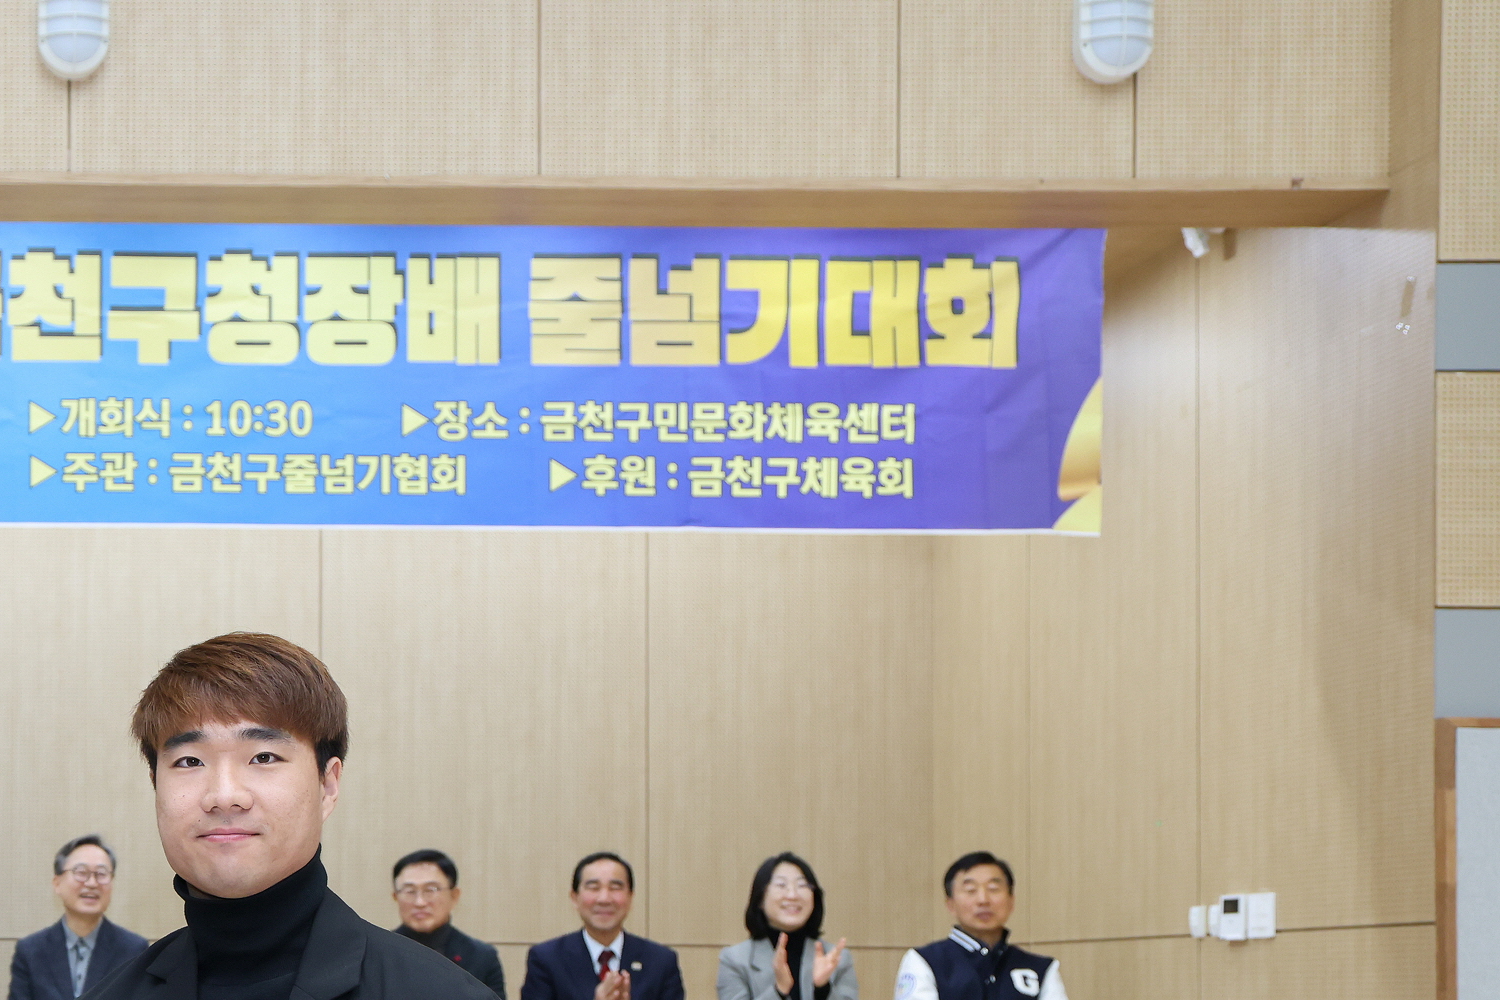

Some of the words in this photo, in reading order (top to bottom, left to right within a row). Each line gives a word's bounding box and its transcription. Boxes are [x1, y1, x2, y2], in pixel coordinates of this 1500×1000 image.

[527, 253, 1021, 367] 줄넘기대회
[60, 397, 171, 438] 개회식
[204, 399, 314, 438] 10:30
[432, 400, 510, 442] 장소
[539, 400, 916, 445] 금천구민문화체육센터
[61, 451, 139, 493] 주관
[168, 451, 467, 496] 금천구줄넘기협회
[580, 453, 658, 497] 후원
[687, 454, 915, 500] 금천구체육회
[1010, 968, 1040, 997] G
